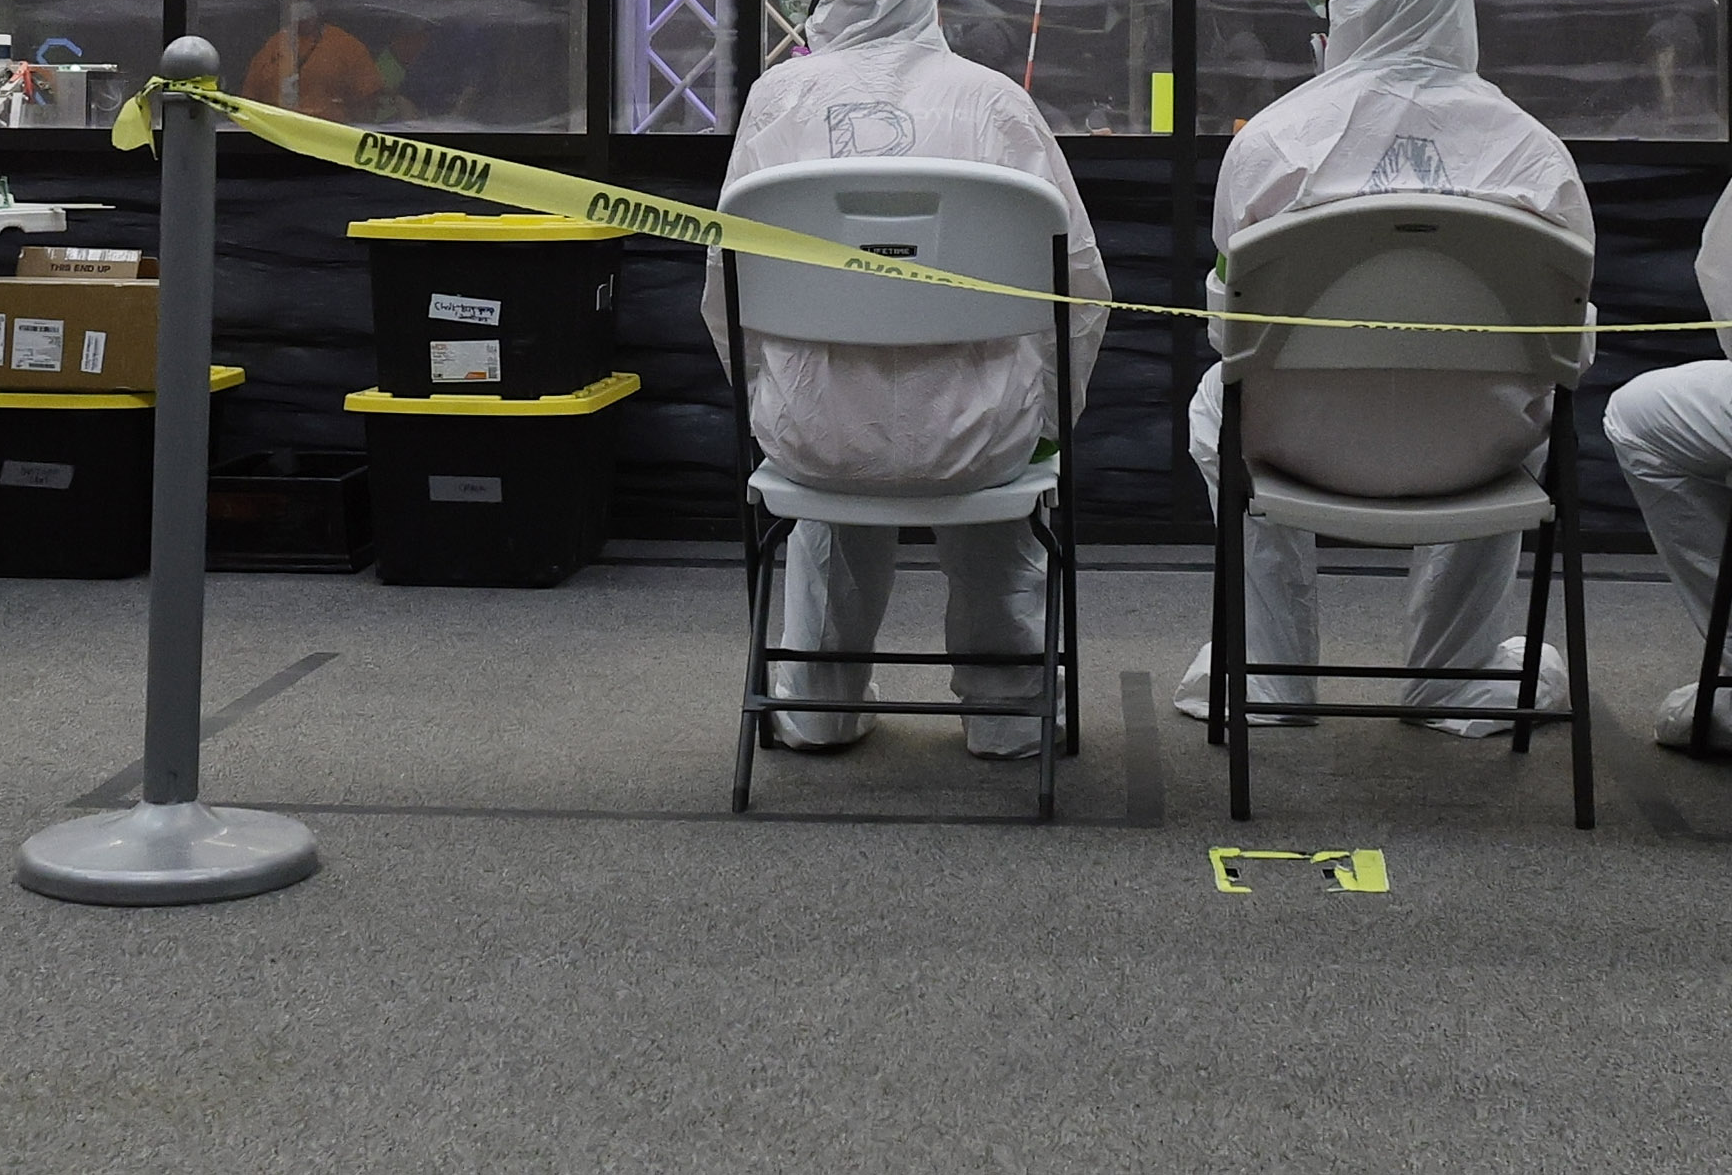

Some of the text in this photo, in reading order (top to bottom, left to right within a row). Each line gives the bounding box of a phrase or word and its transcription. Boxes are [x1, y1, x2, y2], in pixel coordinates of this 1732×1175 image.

[50, 263, 112, 273] THIS END UP
